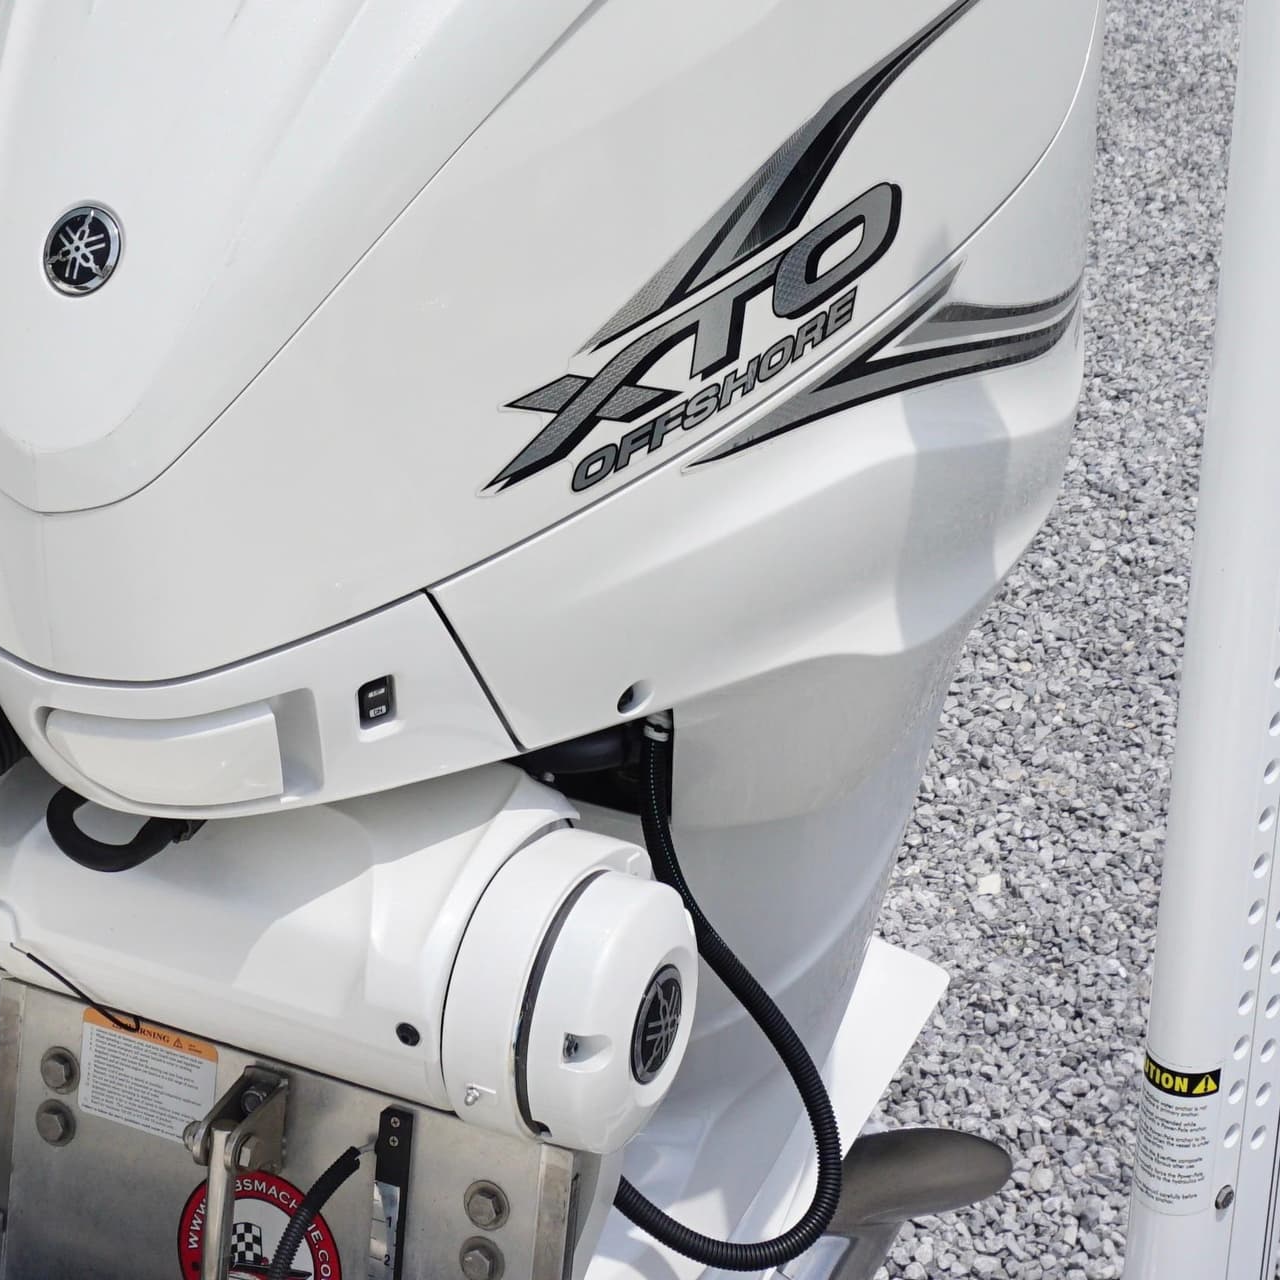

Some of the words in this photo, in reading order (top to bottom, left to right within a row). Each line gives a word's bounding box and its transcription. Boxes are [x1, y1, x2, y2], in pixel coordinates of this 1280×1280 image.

[482, 182, 903, 494] XTO
[571, 285, 858, 493] OFFSHORE
[384, 1255, 392, 1267] 2
